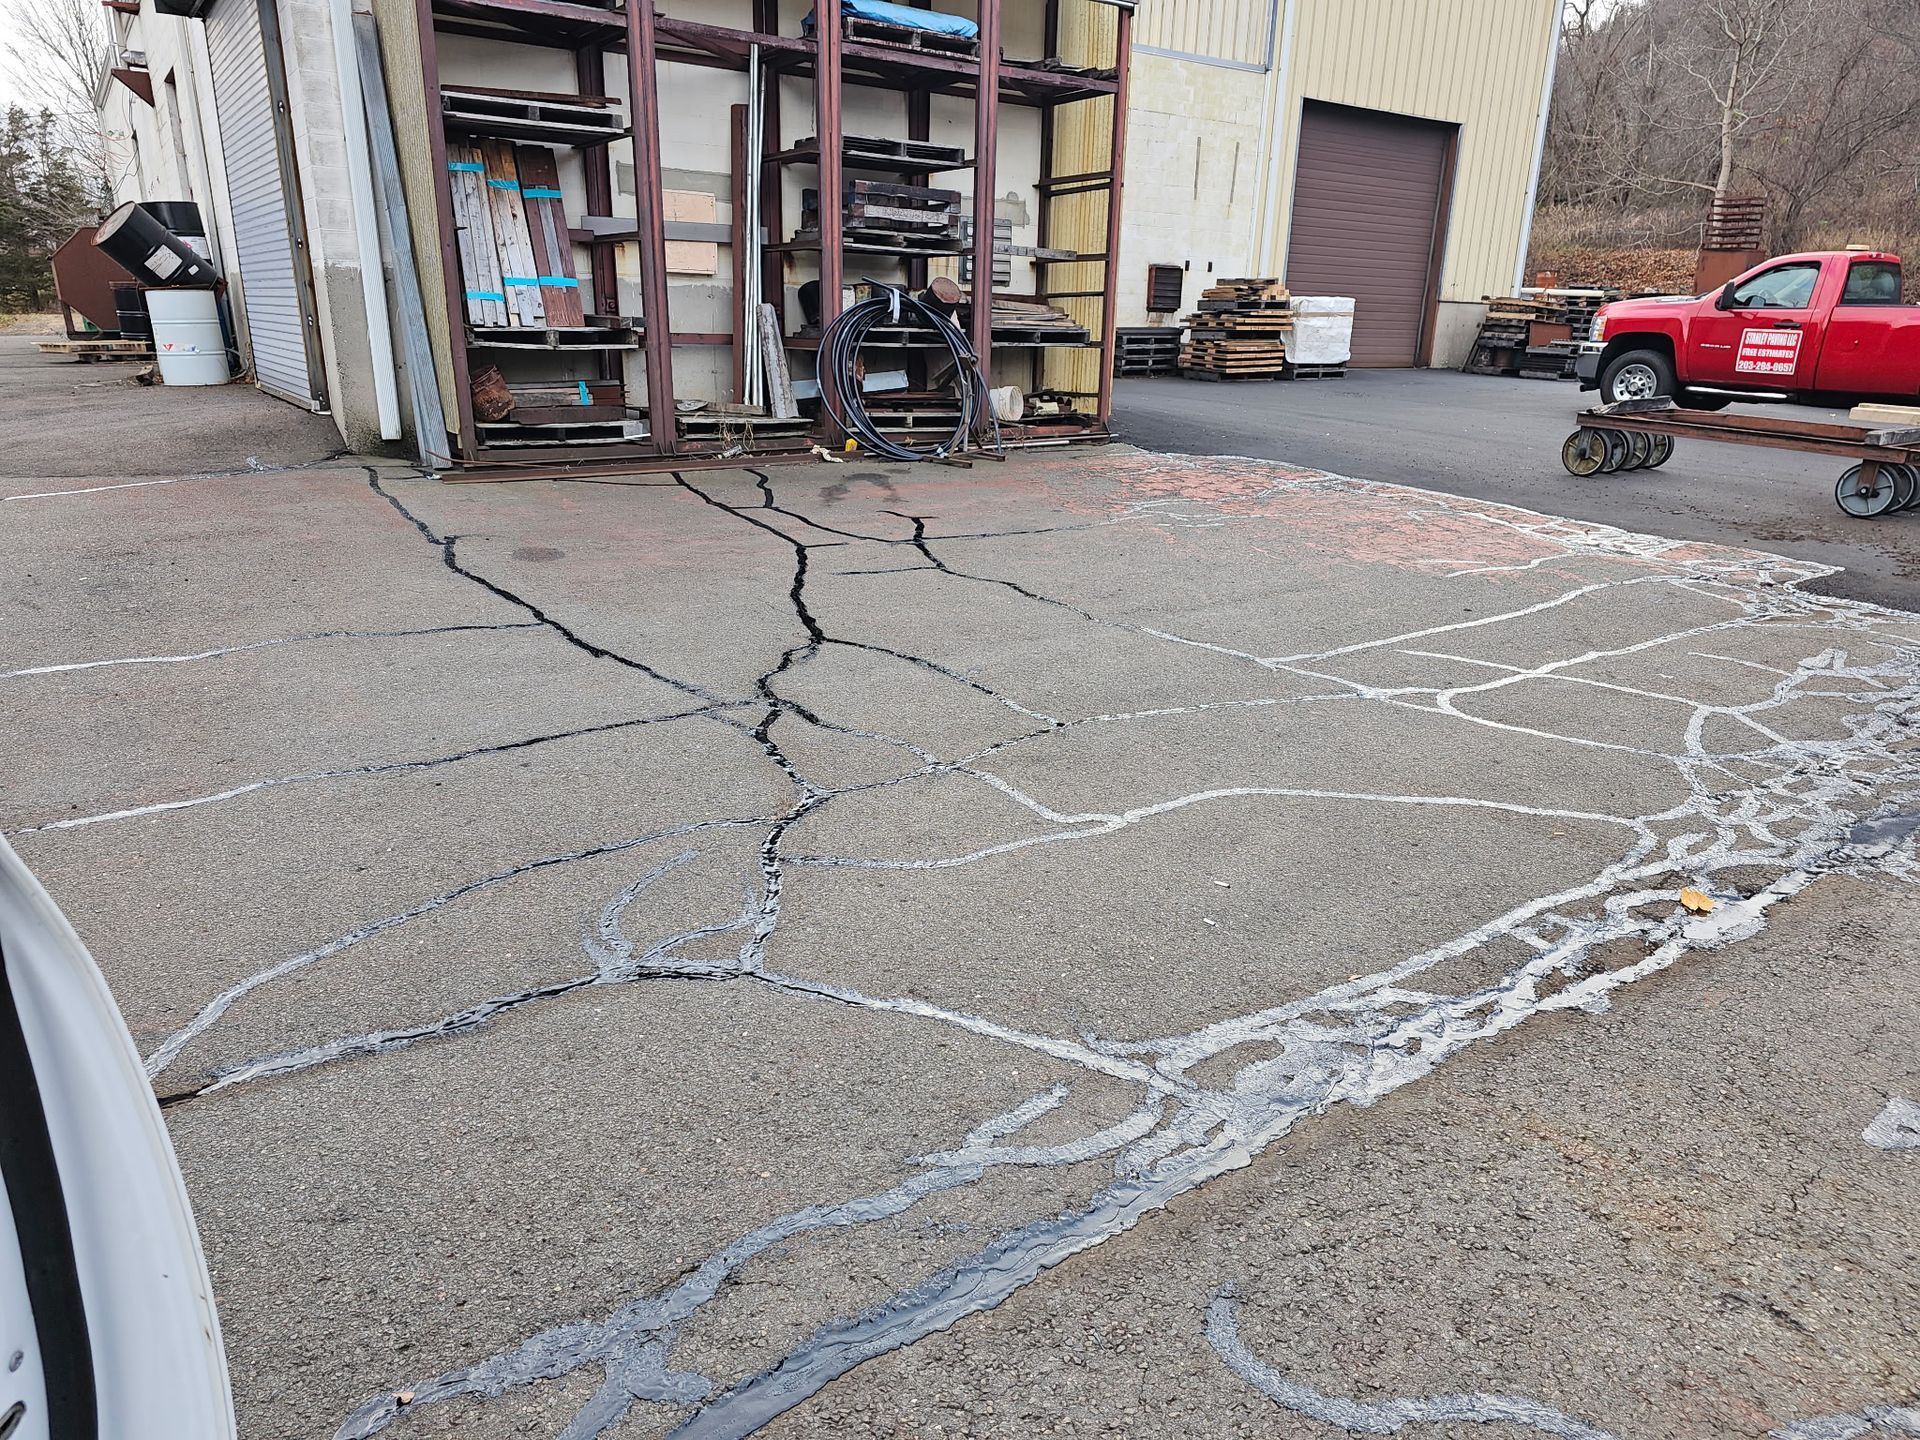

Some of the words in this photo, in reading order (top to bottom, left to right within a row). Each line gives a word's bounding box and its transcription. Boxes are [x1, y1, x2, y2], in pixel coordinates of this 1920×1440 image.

[1745, 332, 1768, 345] STANLEY
[1767, 332, 1788, 346] PAVING
[1786, 333, 1798, 346] LLC
[1742, 347, 1758, 356] FREE
[1758, 348, 1795, 358] ESTIMATES
